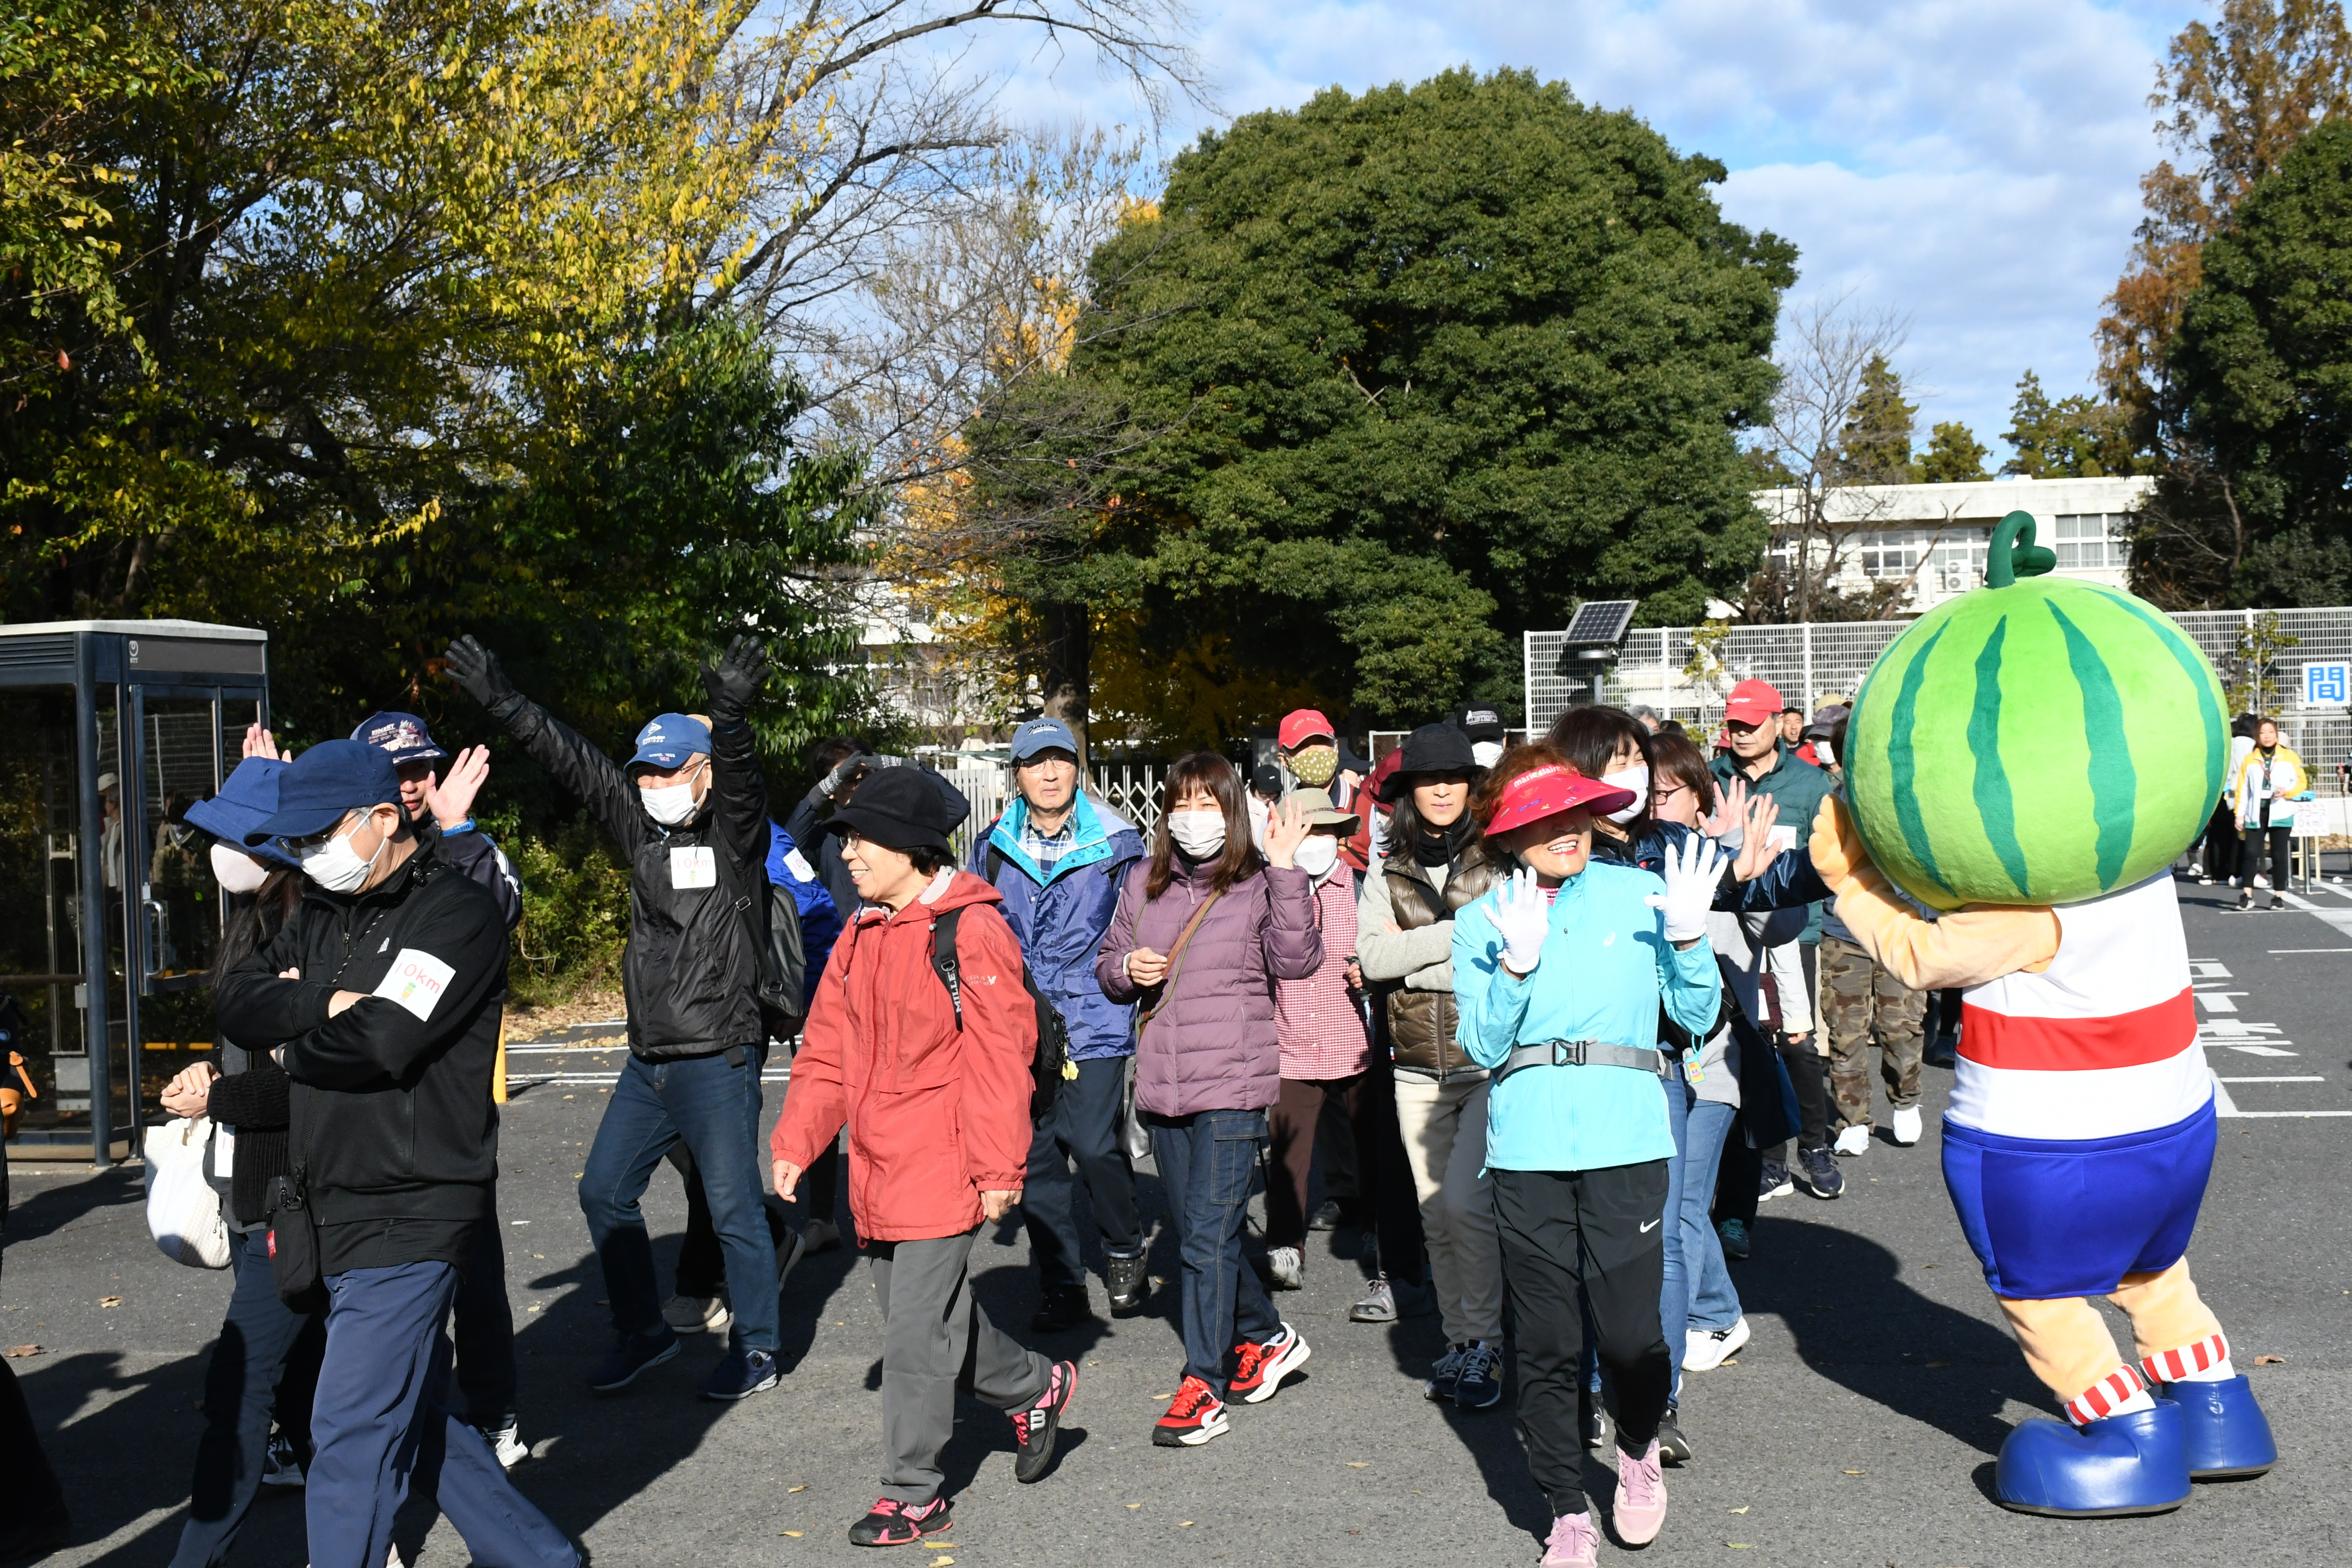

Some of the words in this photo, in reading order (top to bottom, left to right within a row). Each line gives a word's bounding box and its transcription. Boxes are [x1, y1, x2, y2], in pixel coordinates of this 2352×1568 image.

[2309, 667, 2344, 702] 間
[372, 724, 395, 735] VIOLENT
[1293, 719, 1304, 730] TOMI
[1514, 772, 1538, 788] marie
[1538, 765, 1562, 776] claire
[677, 858, 711, 869] 10km
[395, 961, 441, 994] 10km
